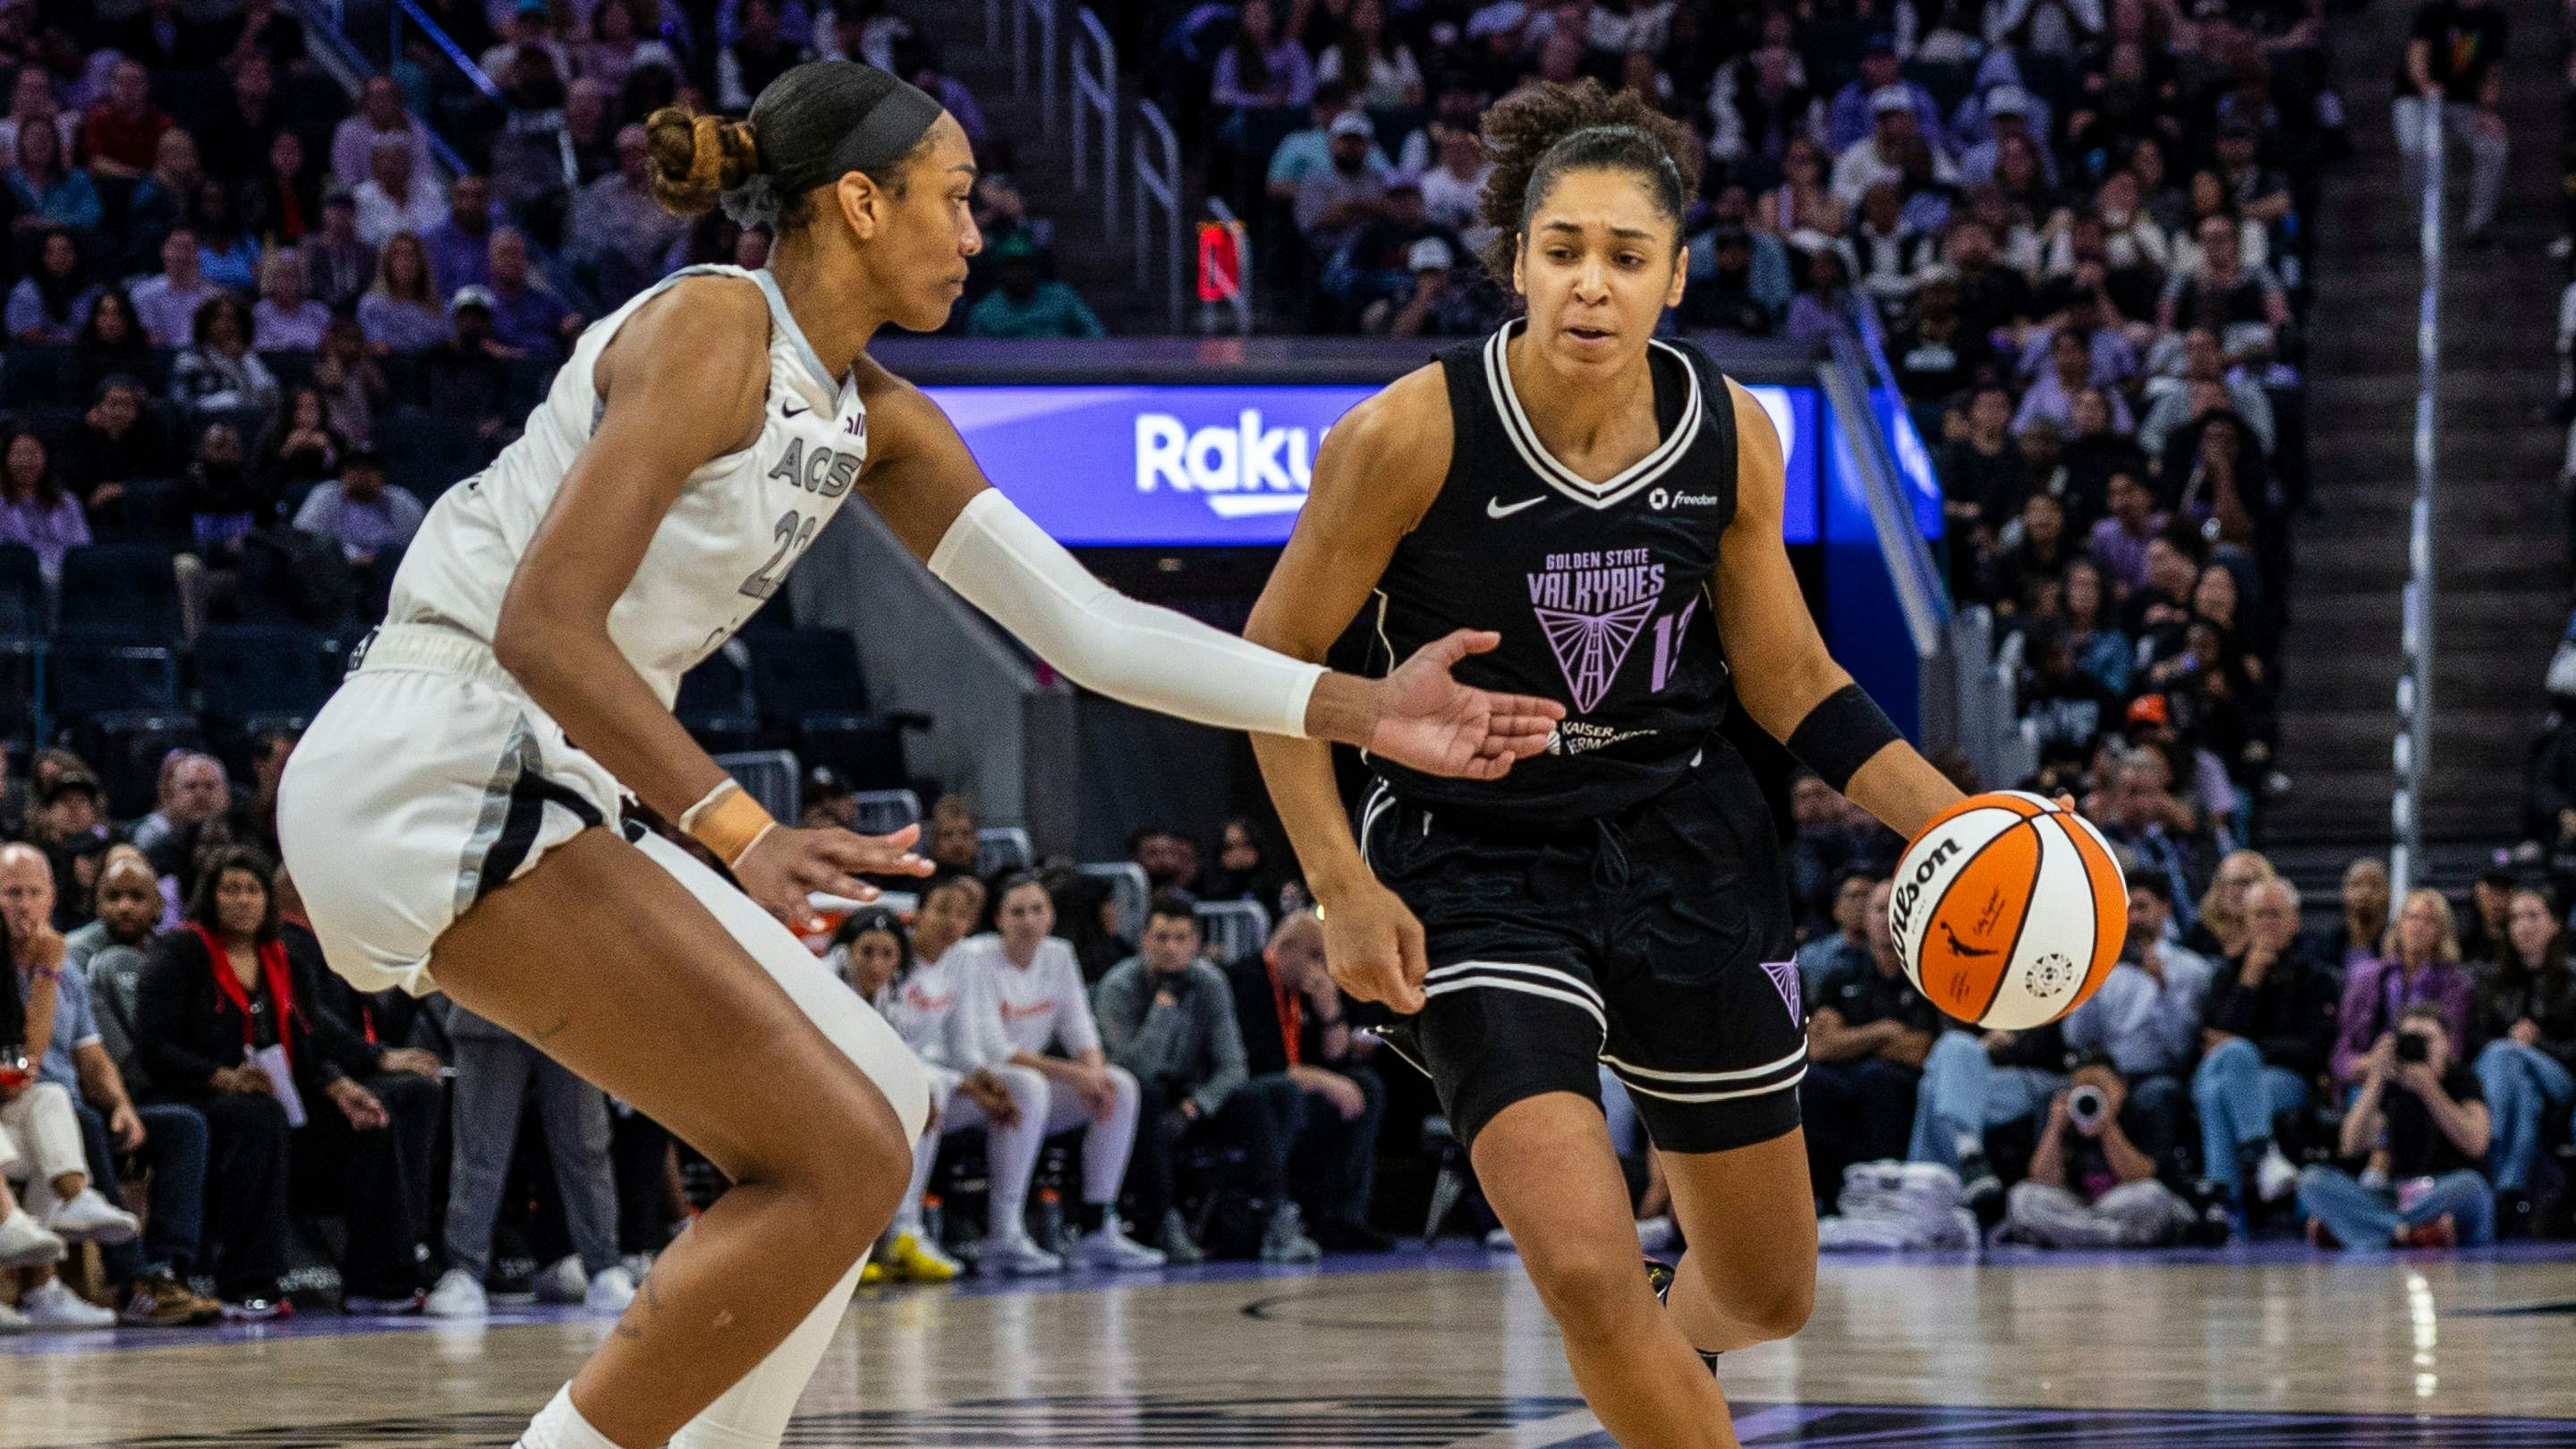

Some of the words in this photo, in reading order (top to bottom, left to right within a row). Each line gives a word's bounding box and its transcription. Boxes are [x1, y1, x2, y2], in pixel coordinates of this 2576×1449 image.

[844, 412, 864, 437] all
[1135, 408, 1331, 491] Raku
[768, 437, 863, 498] ACS
[1671, 490, 1718, 508] freedom
[1545, 551, 1602, 571] GOLDEN
[1605, 548, 1649, 567] STATE
[1526, 563, 1665, 614] VALKYRIES
[1561, 721, 1614, 737] KAISER
